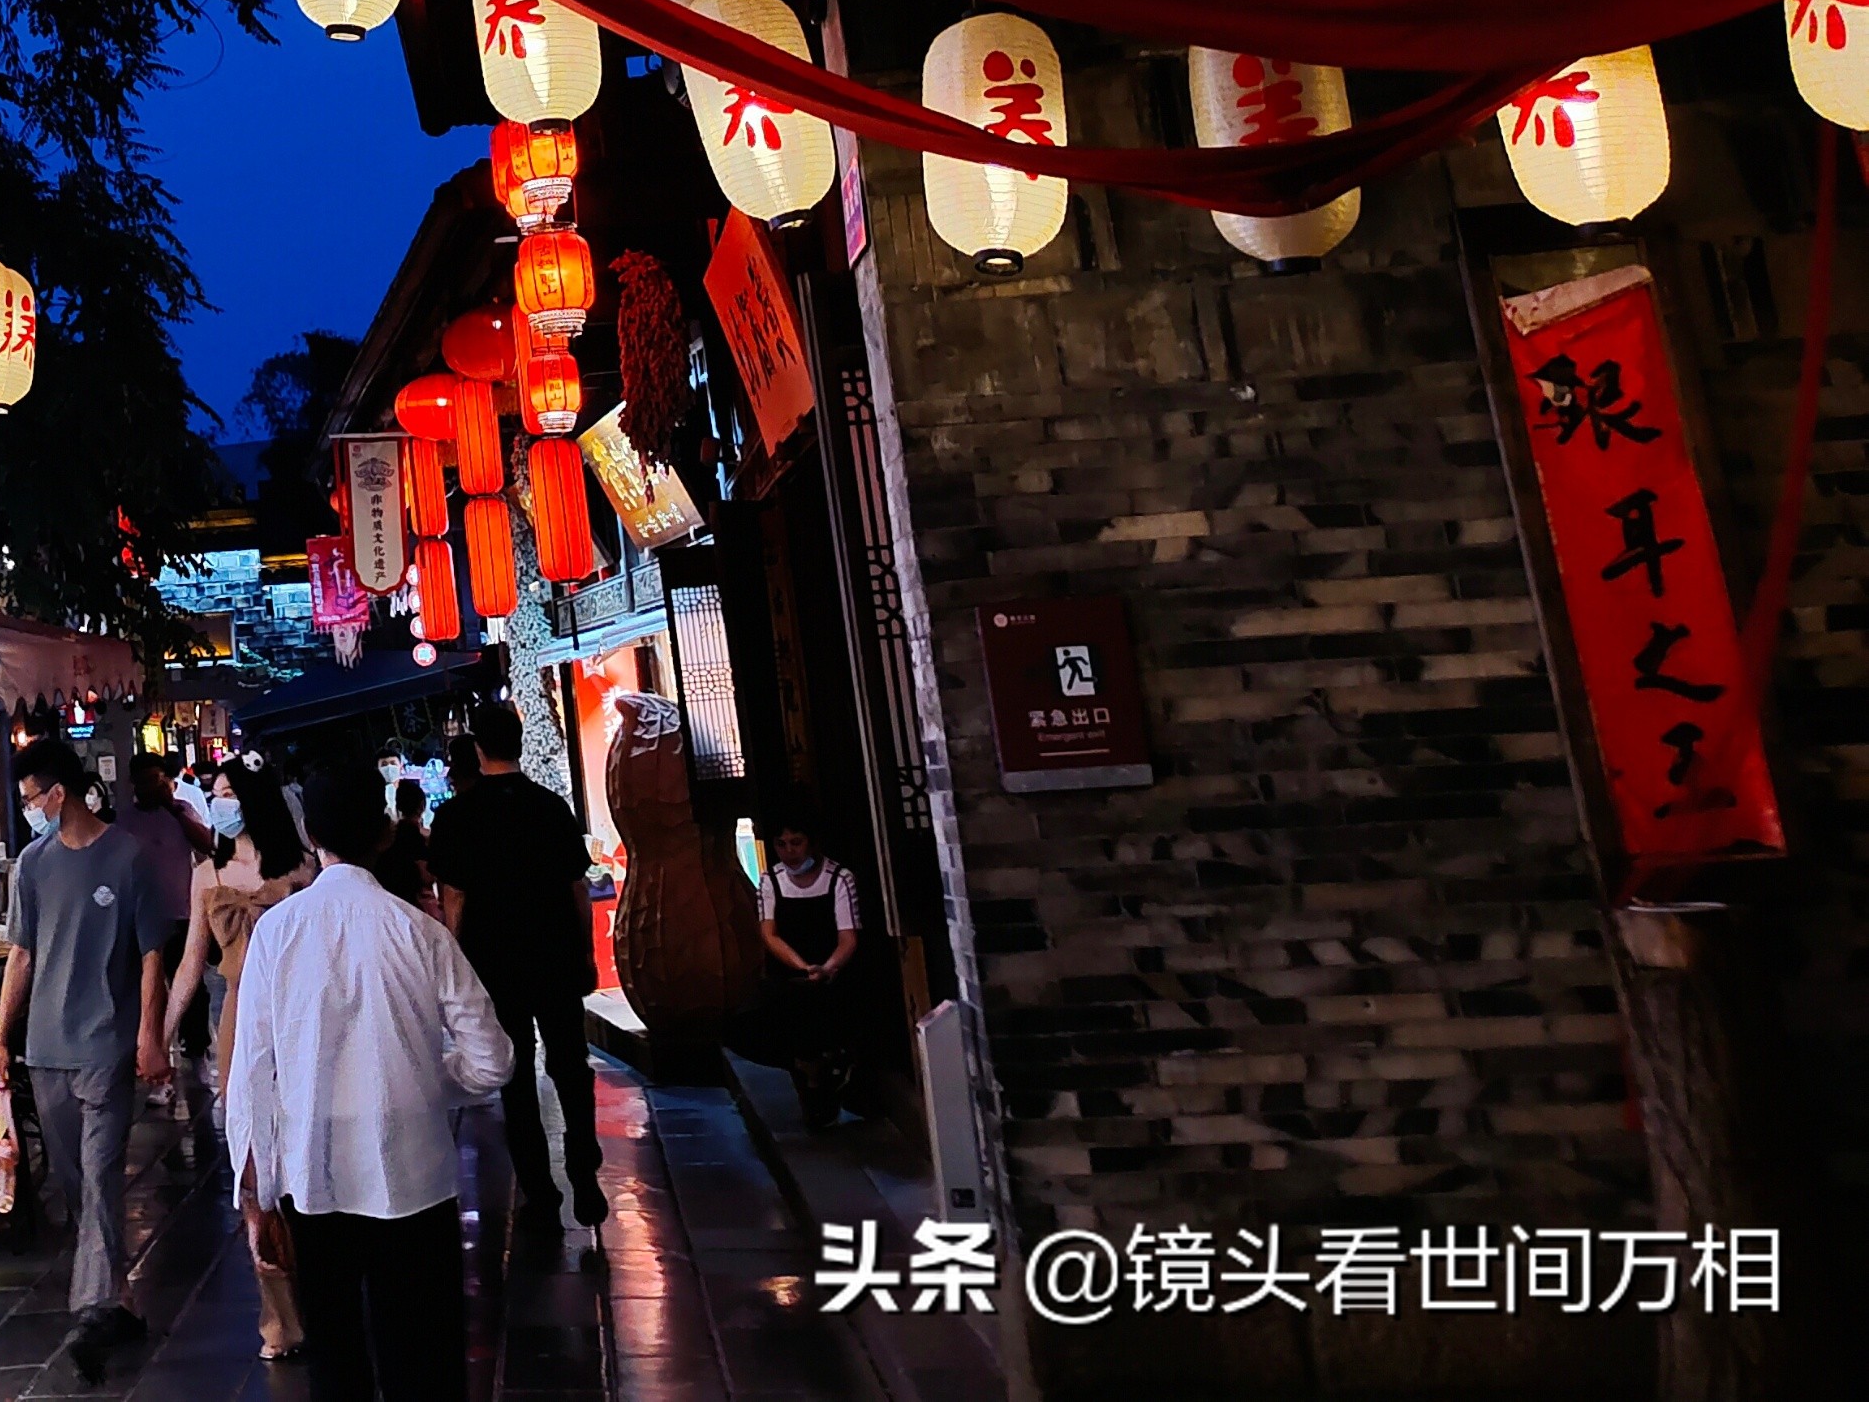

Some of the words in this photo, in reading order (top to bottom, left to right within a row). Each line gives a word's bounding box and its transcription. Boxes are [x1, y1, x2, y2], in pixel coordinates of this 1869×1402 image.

[370, 494, 387, 584] 非物质文化遗产
[1526, 355, 1737, 819] 銀耳之王
